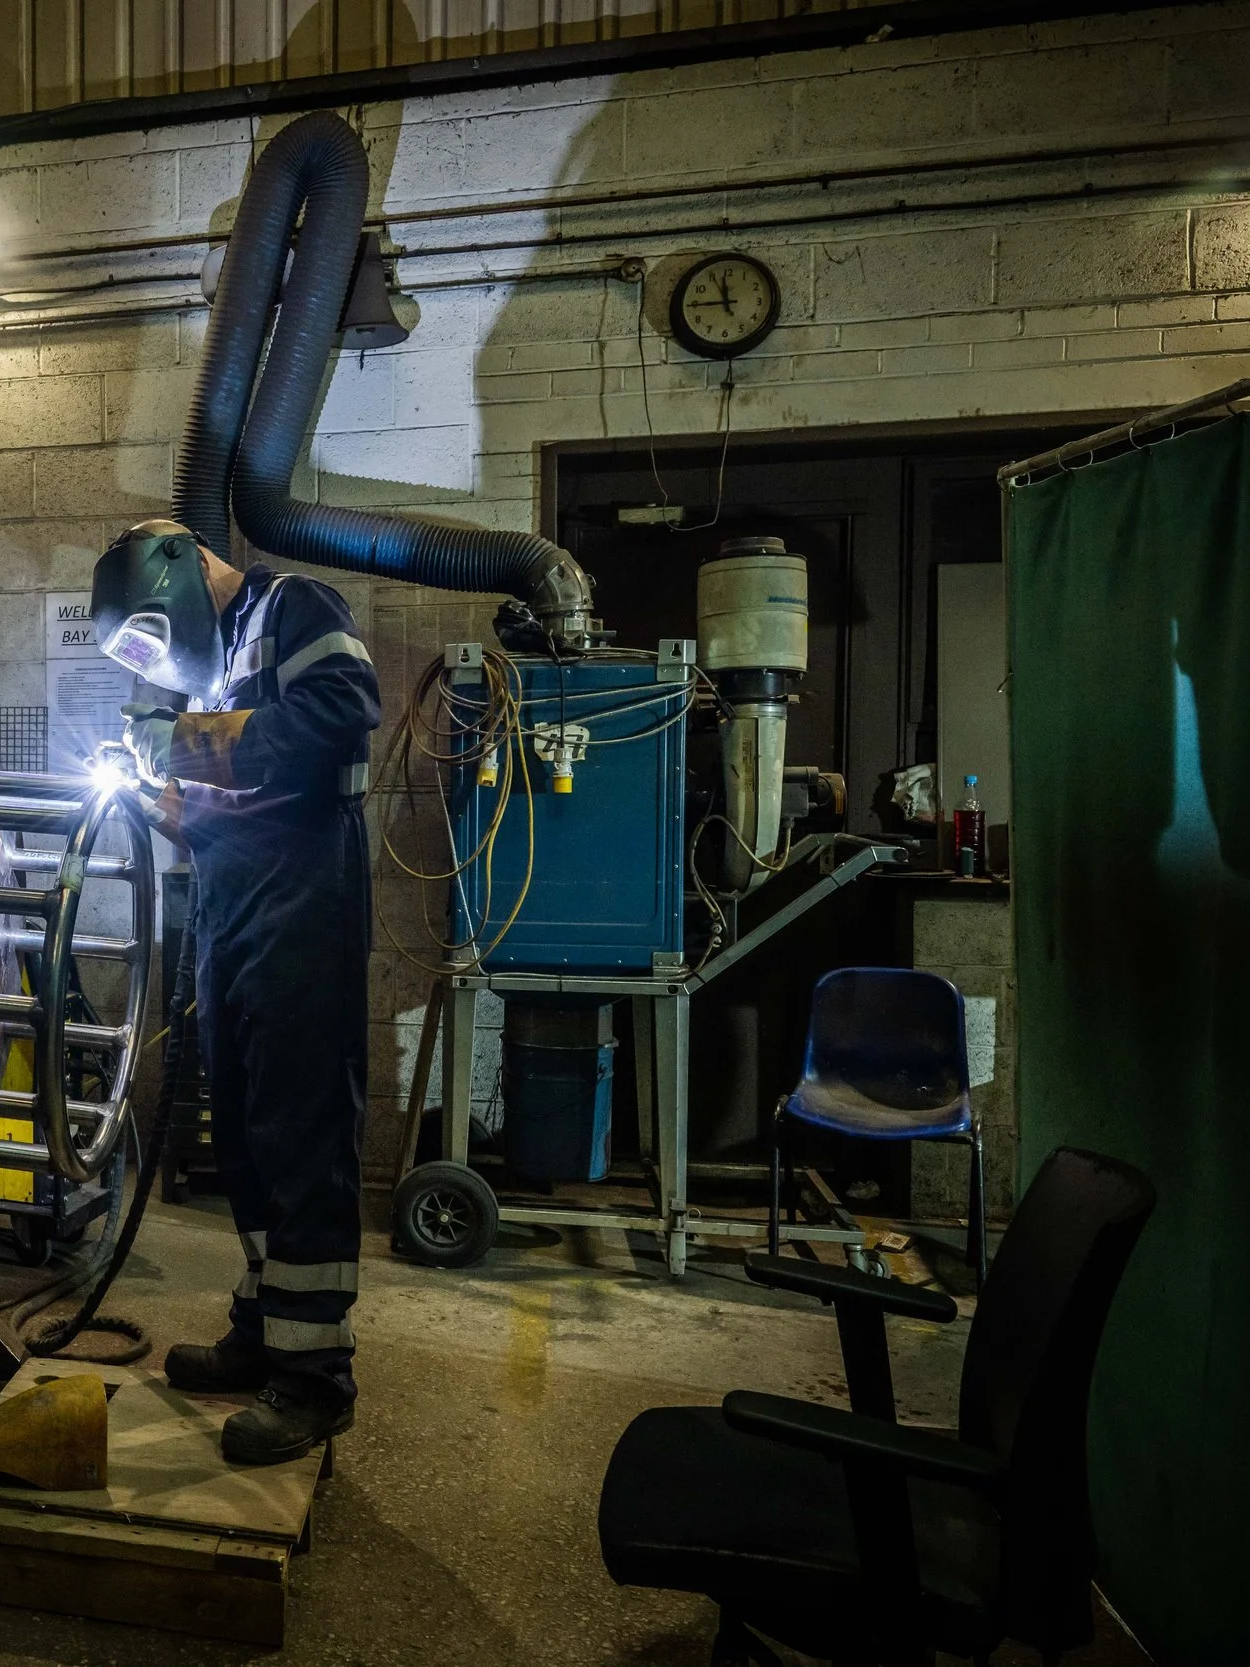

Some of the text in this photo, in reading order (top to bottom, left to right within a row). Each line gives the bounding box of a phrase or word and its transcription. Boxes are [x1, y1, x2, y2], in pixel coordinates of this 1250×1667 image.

[724, 269, 733, 277] 12
[695, 285, 706, 293] 10
[695, 315, 700, 323] 8
[739, 325, 744, 333] 5
[62, 630, 90, 643] BAY
